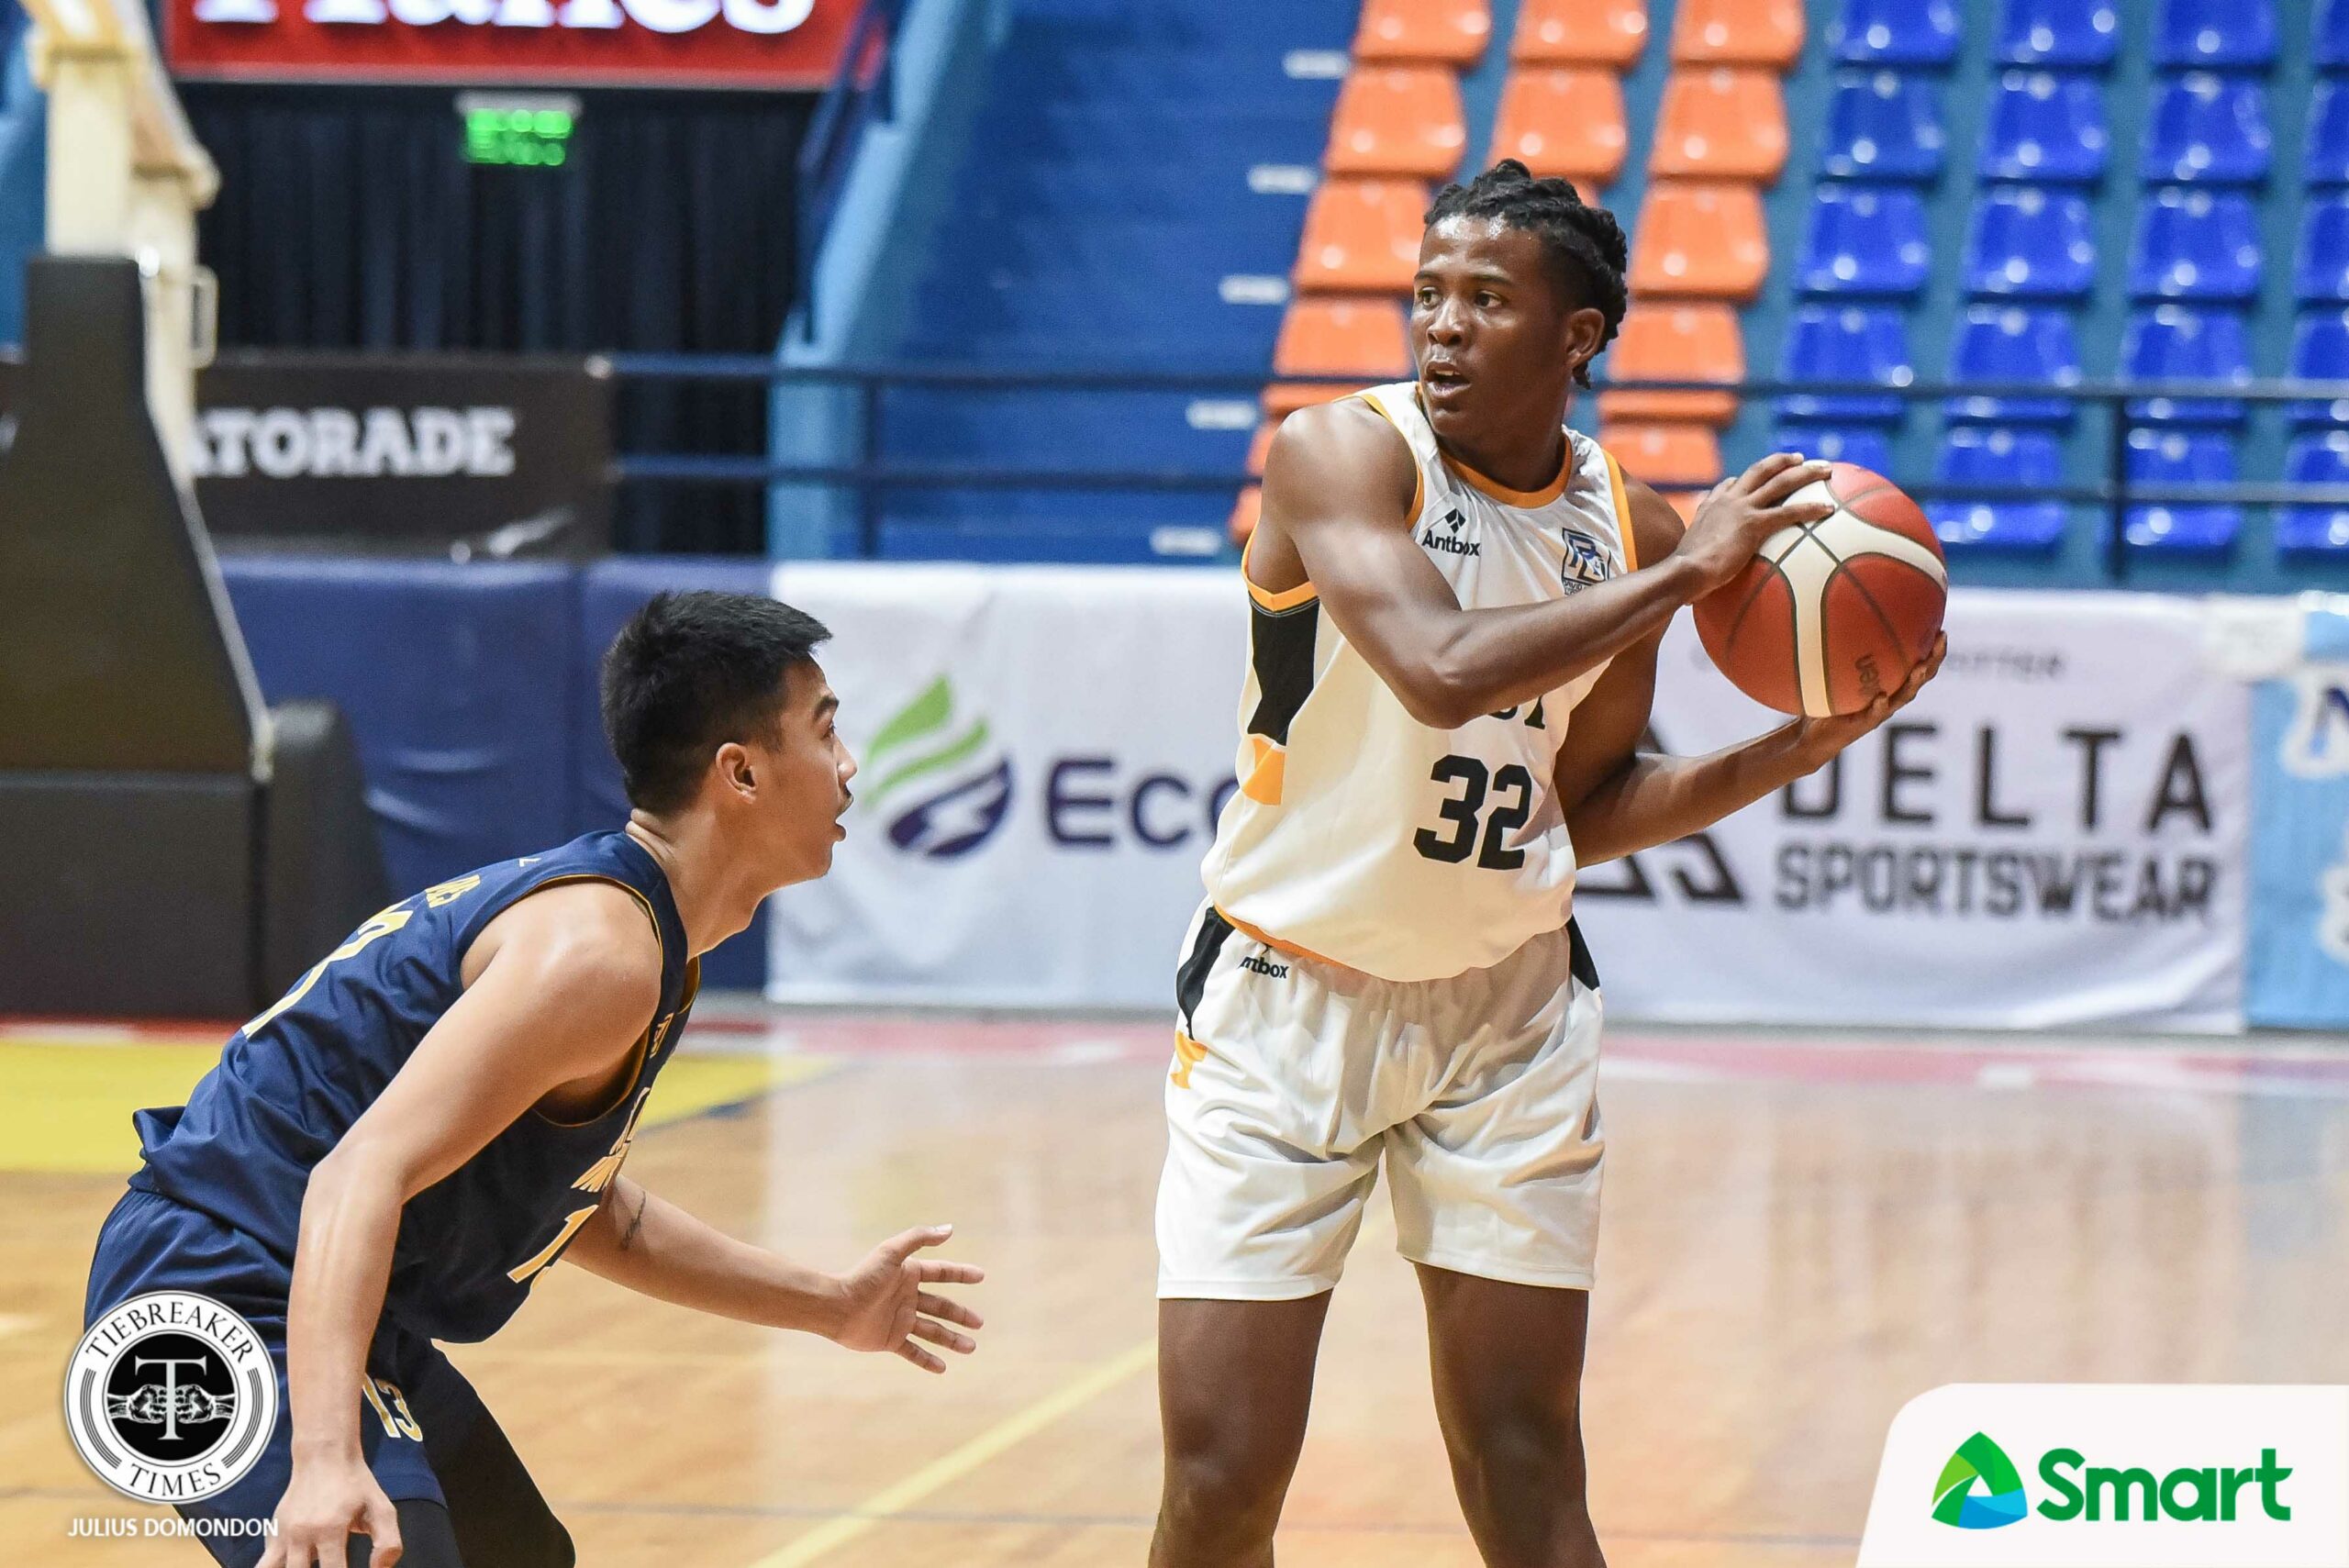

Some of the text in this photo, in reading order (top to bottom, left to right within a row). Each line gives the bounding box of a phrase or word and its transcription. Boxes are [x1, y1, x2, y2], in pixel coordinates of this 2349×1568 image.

[1421, 528, 1480, 556] Antbox
[1413, 754, 1531, 870] 32
[1773, 840, 2218, 921] SPORTSWEAR
